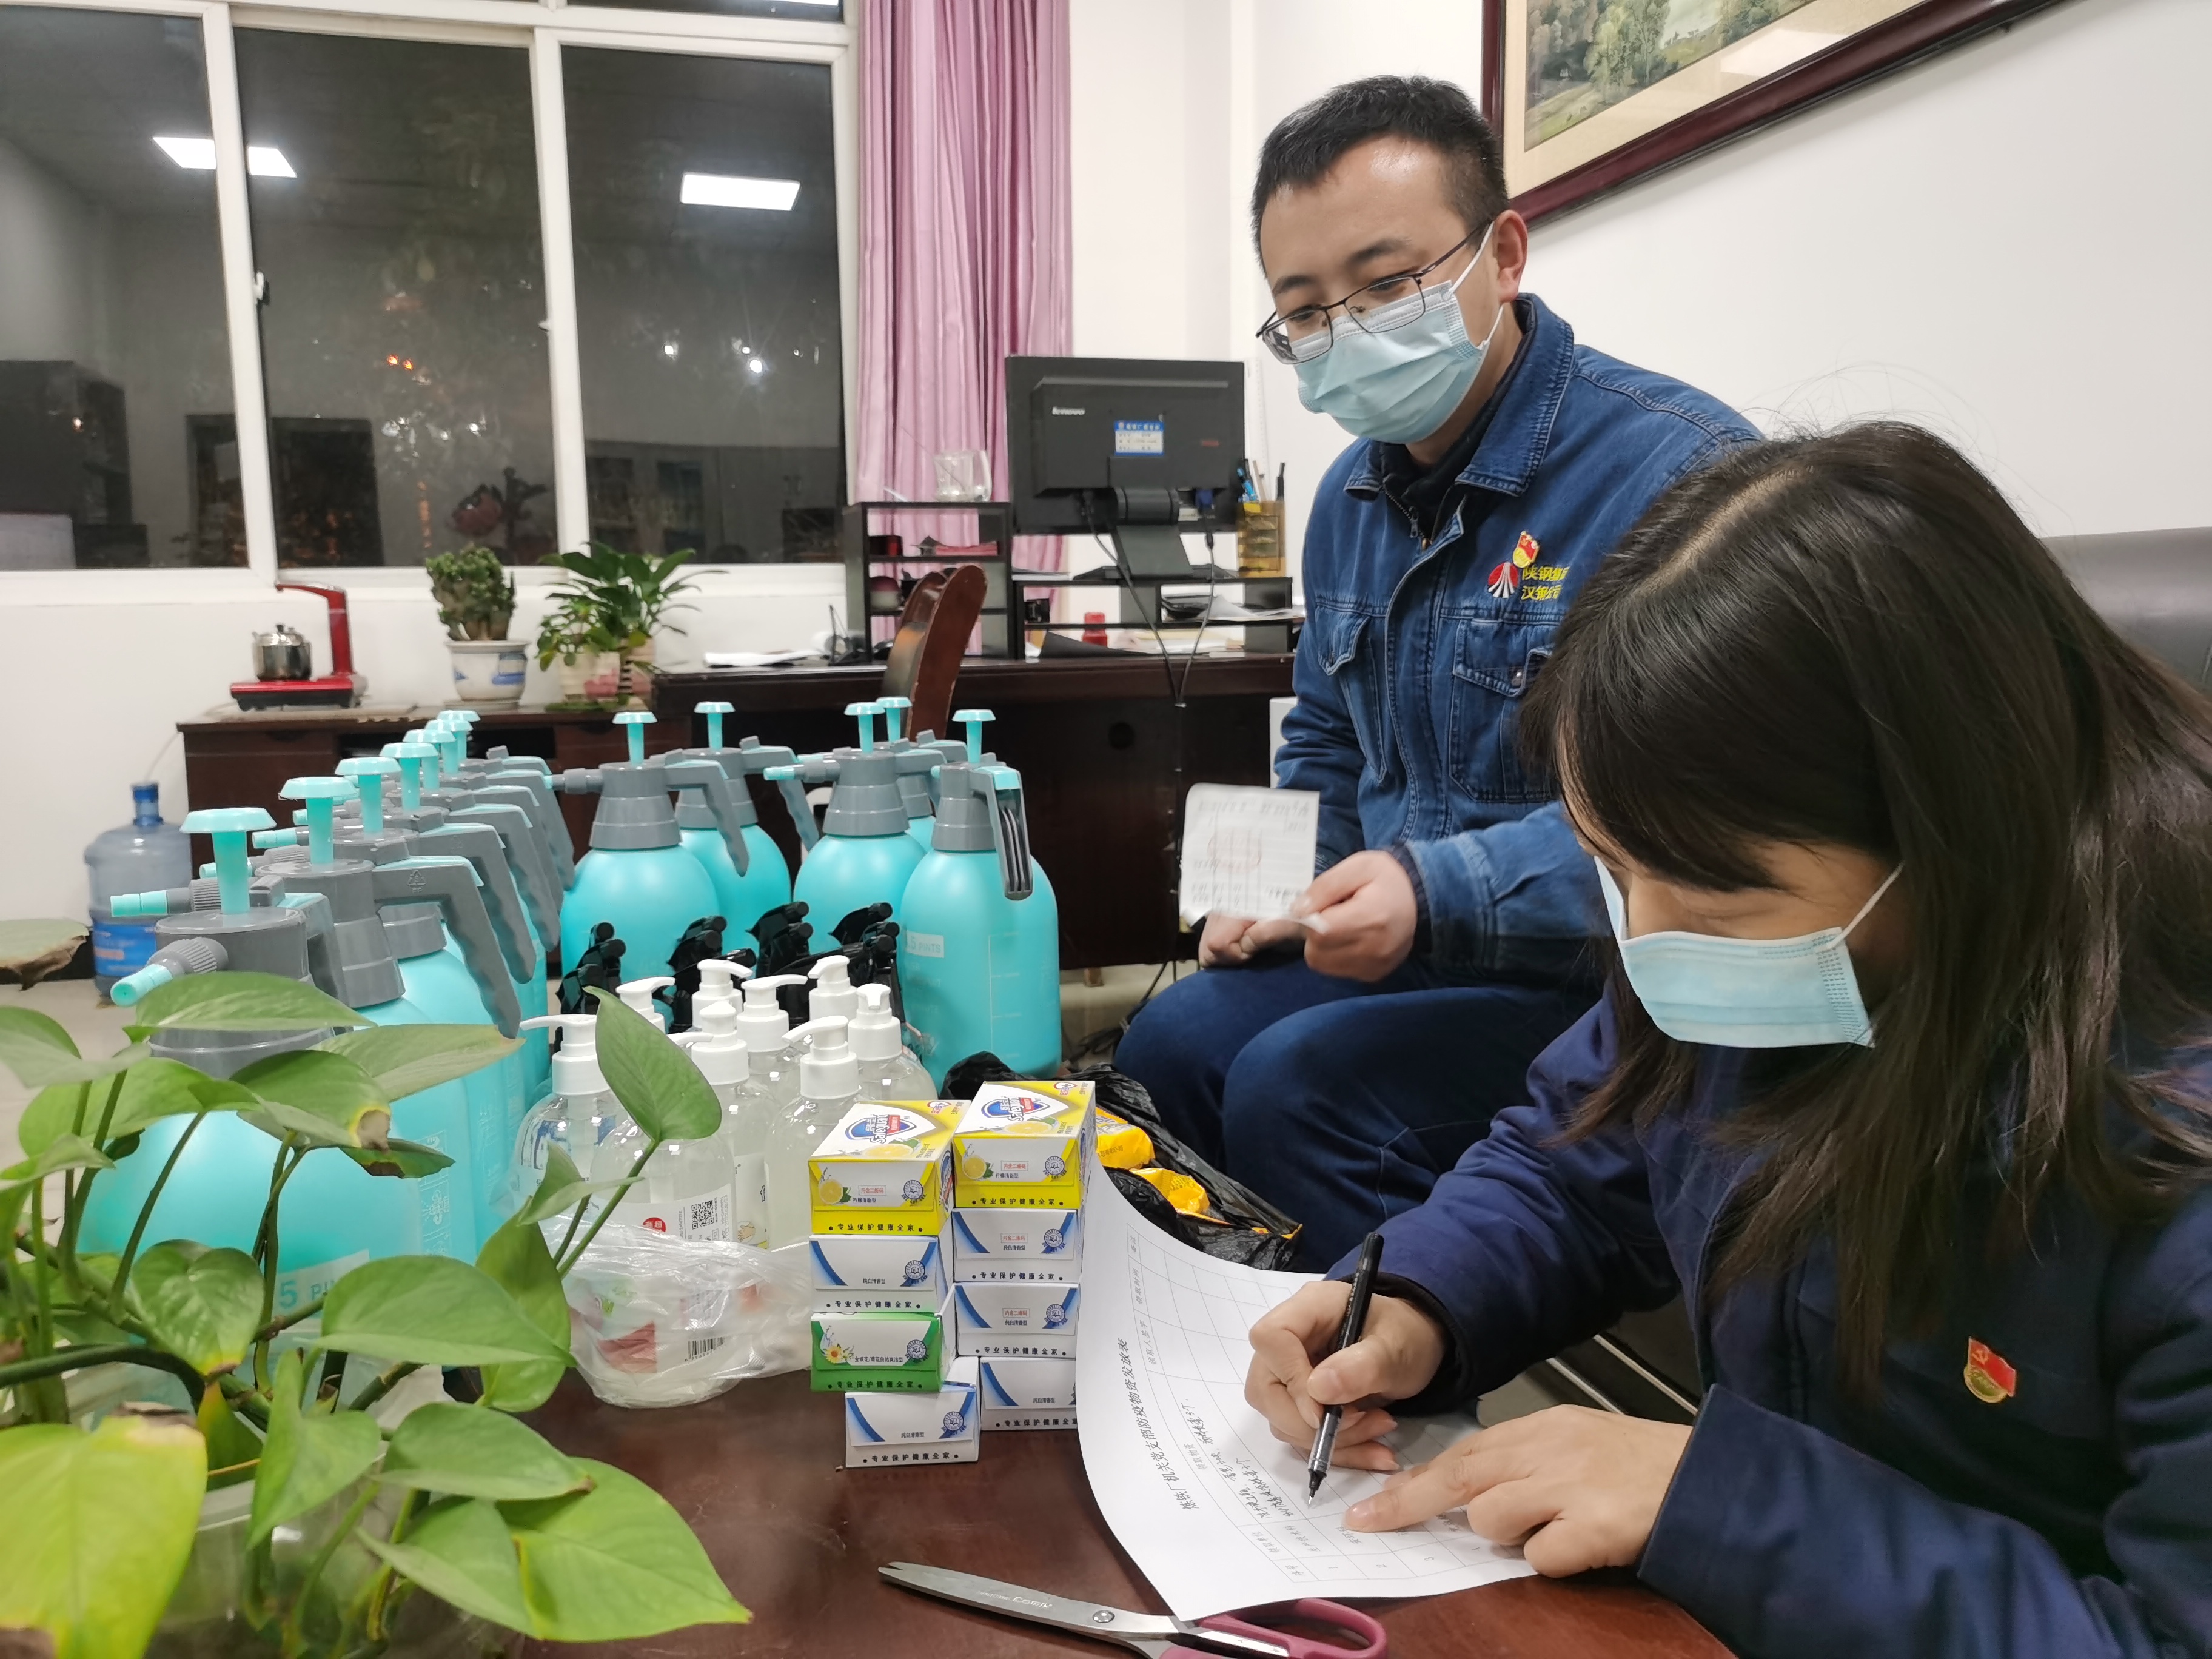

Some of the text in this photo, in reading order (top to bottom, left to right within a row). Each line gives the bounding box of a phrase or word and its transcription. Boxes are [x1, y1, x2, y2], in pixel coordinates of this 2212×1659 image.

[1007, 1096, 1025, 1122] Safeguard
[869, 1114, 890, 1144] Safeguard
[980, 1197, 1055, 1206] 专业保护健康全家
[837, 1222, 914, 1232] 专业保护健康全家
[980, 1272, 1056, 1281] 专业保护健康全家
[1132, 1267, 1143, 1304] 领取时间
[1139, 1319, 1156, 1364] 领取人签字
[984, 1346, 1058, 1355] 专业保护健康全家
[837, 1380, 914, 1389] 专业保护健康全家
[1004, 1418, 1078, 1427] 专业保护健康全家
[1118, 1338, 1199, 1509] 炼铁厂机关党支部防疫物资发放表
[871, 1452, 950, 1462] 专业保护健康全家
